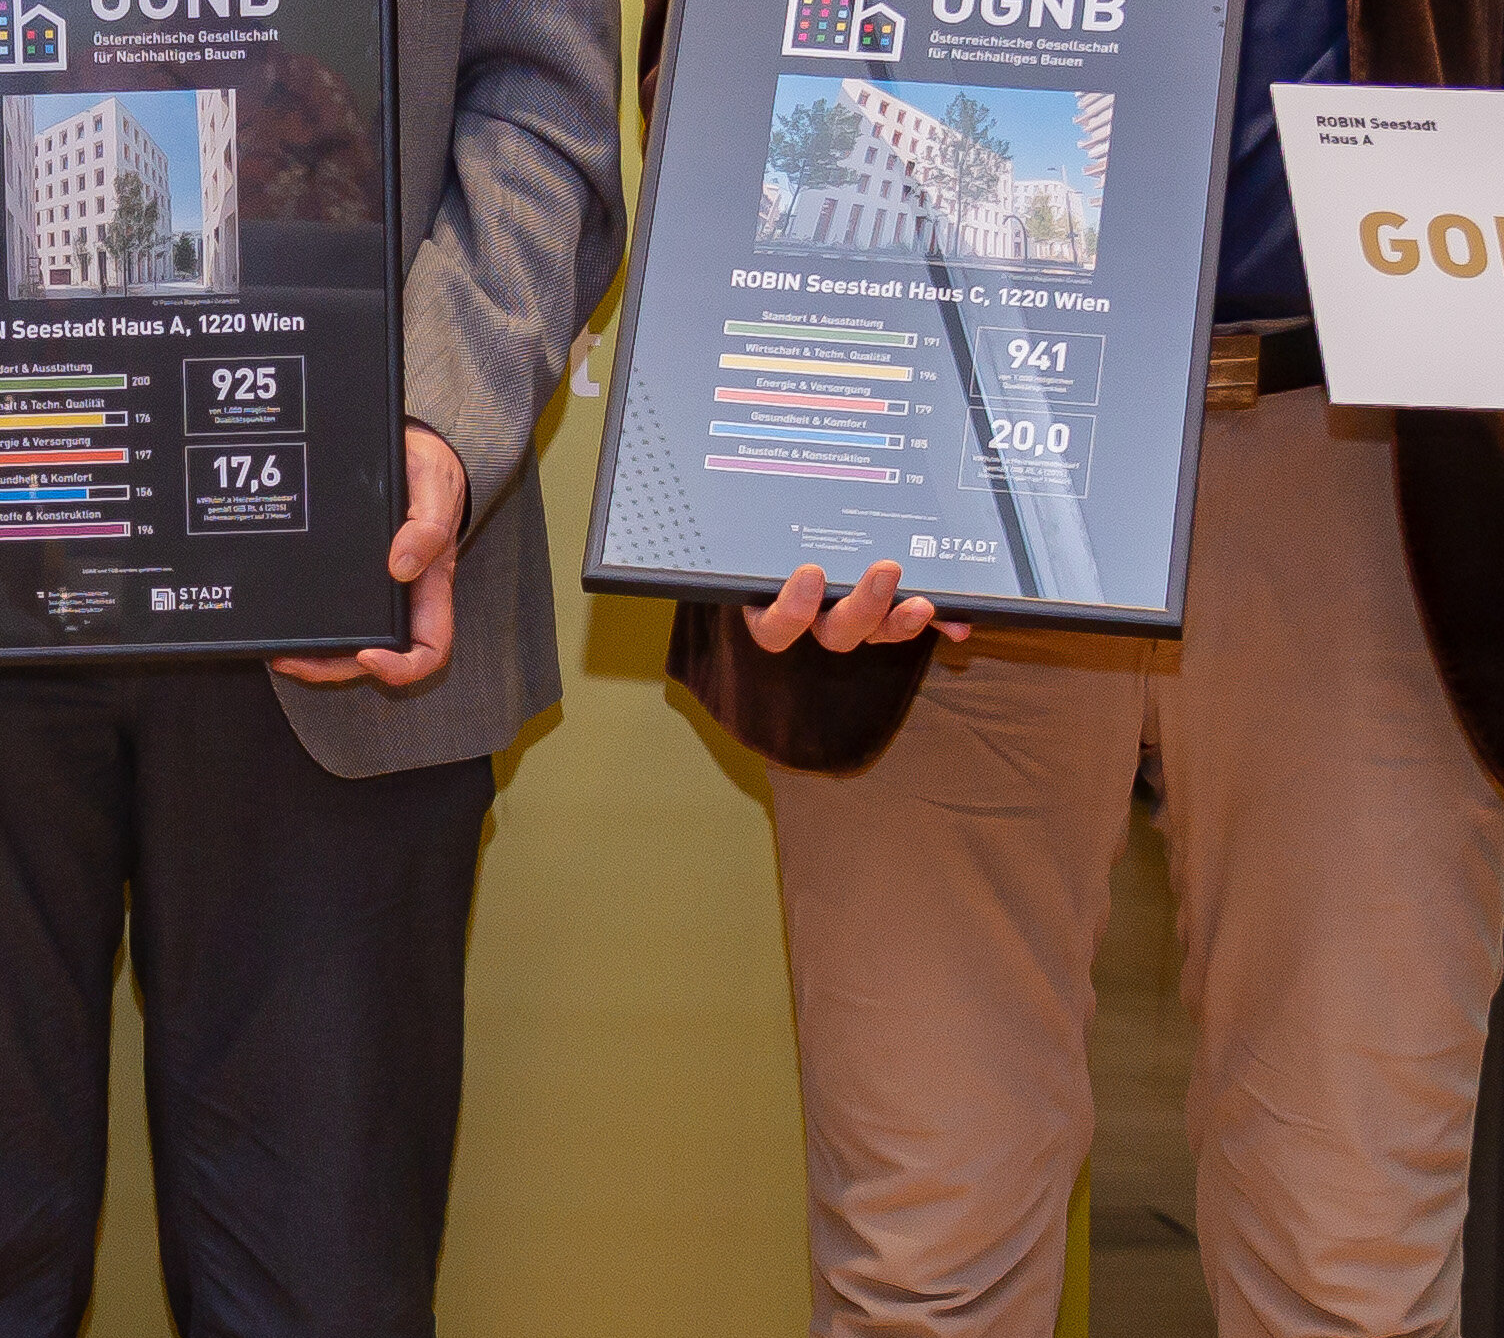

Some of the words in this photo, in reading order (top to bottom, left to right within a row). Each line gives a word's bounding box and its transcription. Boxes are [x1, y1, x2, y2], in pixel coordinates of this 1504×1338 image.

[93, 31, 195, 46] Österreichische
[198, 29, 279, 43] Gesellschaft
[929, 30, 1033, 49] Österreichische
[1036, 38, 1119, 54] Gesellschaft
[93, 51, 112, 64] für
[116, 48, 201, 64] Nachhaltiges
[205, 48, 246, 61] Bauen
[928, 47, 947, 59] für
[950, 48, 1037, 67] Nachhaltiges
[1040, 53, 1084, 67] Bauen
[1316, 115, 1366, 129] ROBIN
[1369, 118, 1438, 131] Seestadt
[1319, 133, 1359, 145] Haus
[1362, 134, 1374, 146] A
[730, 268, 800, 291] ROBIN
[805, 276, 902, 300] Seestadt
[908, 281, 963, 303] Haus
[969, 286, 990, 307] C,
[998, 287, 1048, 309] 1220
[1055, 291, 1111, 313] Wien
[12, 317, 105, 340] Seestadt
[112, 316, 164, 338] Haus
[169, 316, 191, 338] A,
[198, 313, 246, 334] 1220
[251, 312, 305, 332] Wien
[1007, 339, 1067, 372] 941
[32, 362, 92, 374] Ausstattung
[132, 376, 150, 387] 200
[212, 367, 277, 400] 925
[32, 437, 91, 449] Versorgung
[987, 418, 1070, 457] 20,0
[50, 472, 92, 483] Komfort
[213, 455, 281, 494] 17,6
[36, 510, 102, 521] Konstruktion
[137, 525, 154, 535] 196
[941, 537, 998, 554] STADT
[179, 586, 232, 600] STADT
